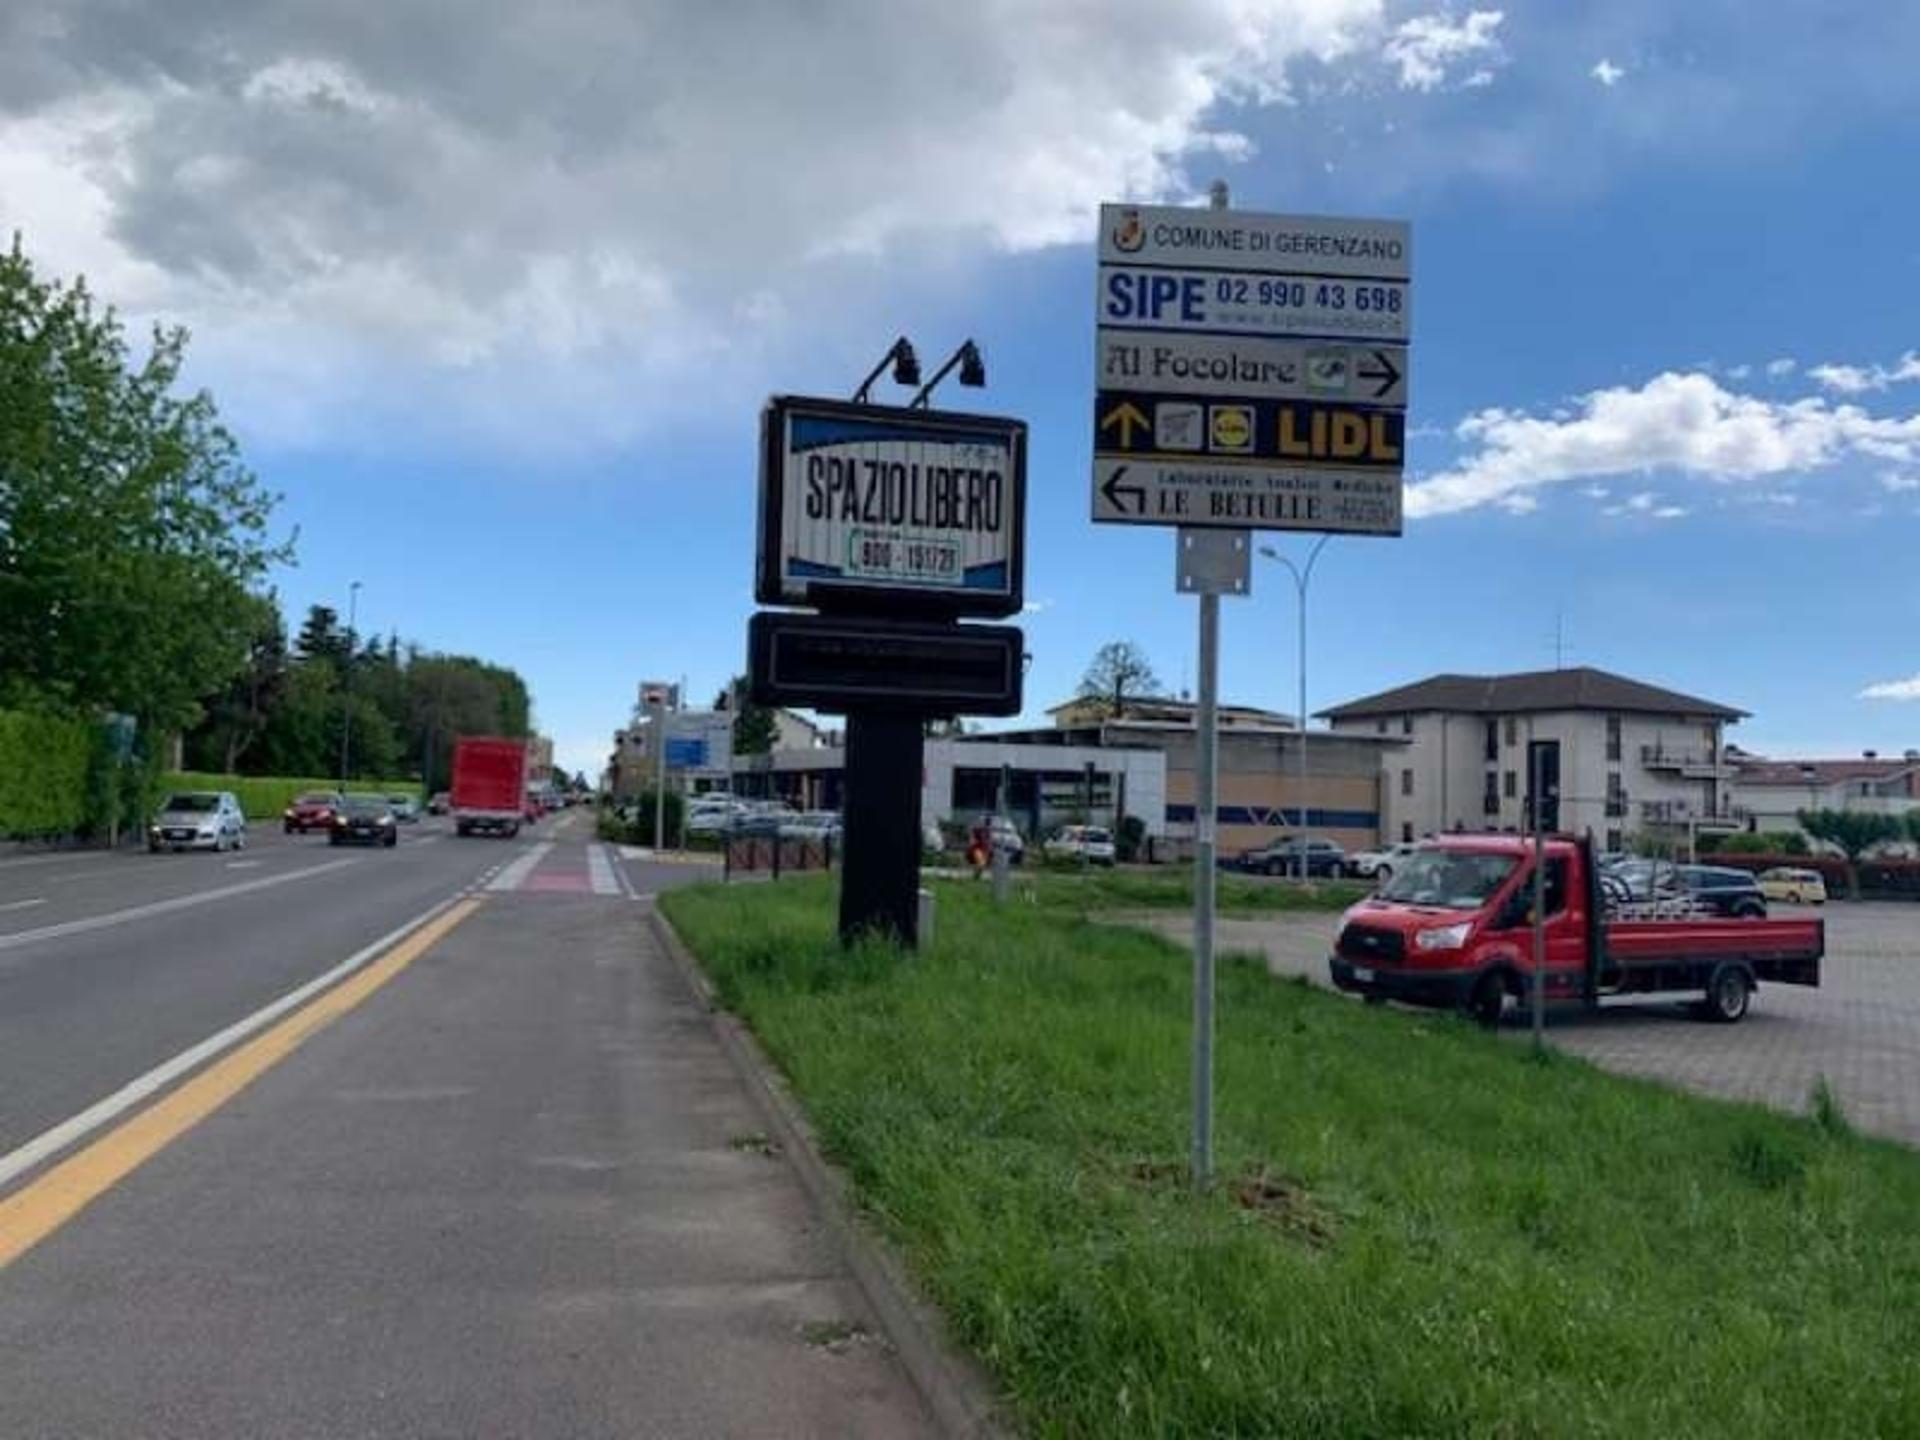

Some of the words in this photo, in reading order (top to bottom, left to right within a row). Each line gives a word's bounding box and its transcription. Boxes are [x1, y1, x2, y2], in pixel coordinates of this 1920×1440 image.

[1153, 223, 1244, 251] COMUNE
[1250, 230, 1271, 252] DI
[1275, 232, 1403, 260] GERENZANO
[1106, 271, 1206, 323] SIPE
[1216, 278, 1249, 305] 02
[1258, 281, 1306, 309] 990
[1151, 346, 1297, 384] Focolare
[1277, 406, 1399, 459] LIDL
[1157, 489, 1191, 516] LE
[1209, 490, 1322, 520] BETULLE
